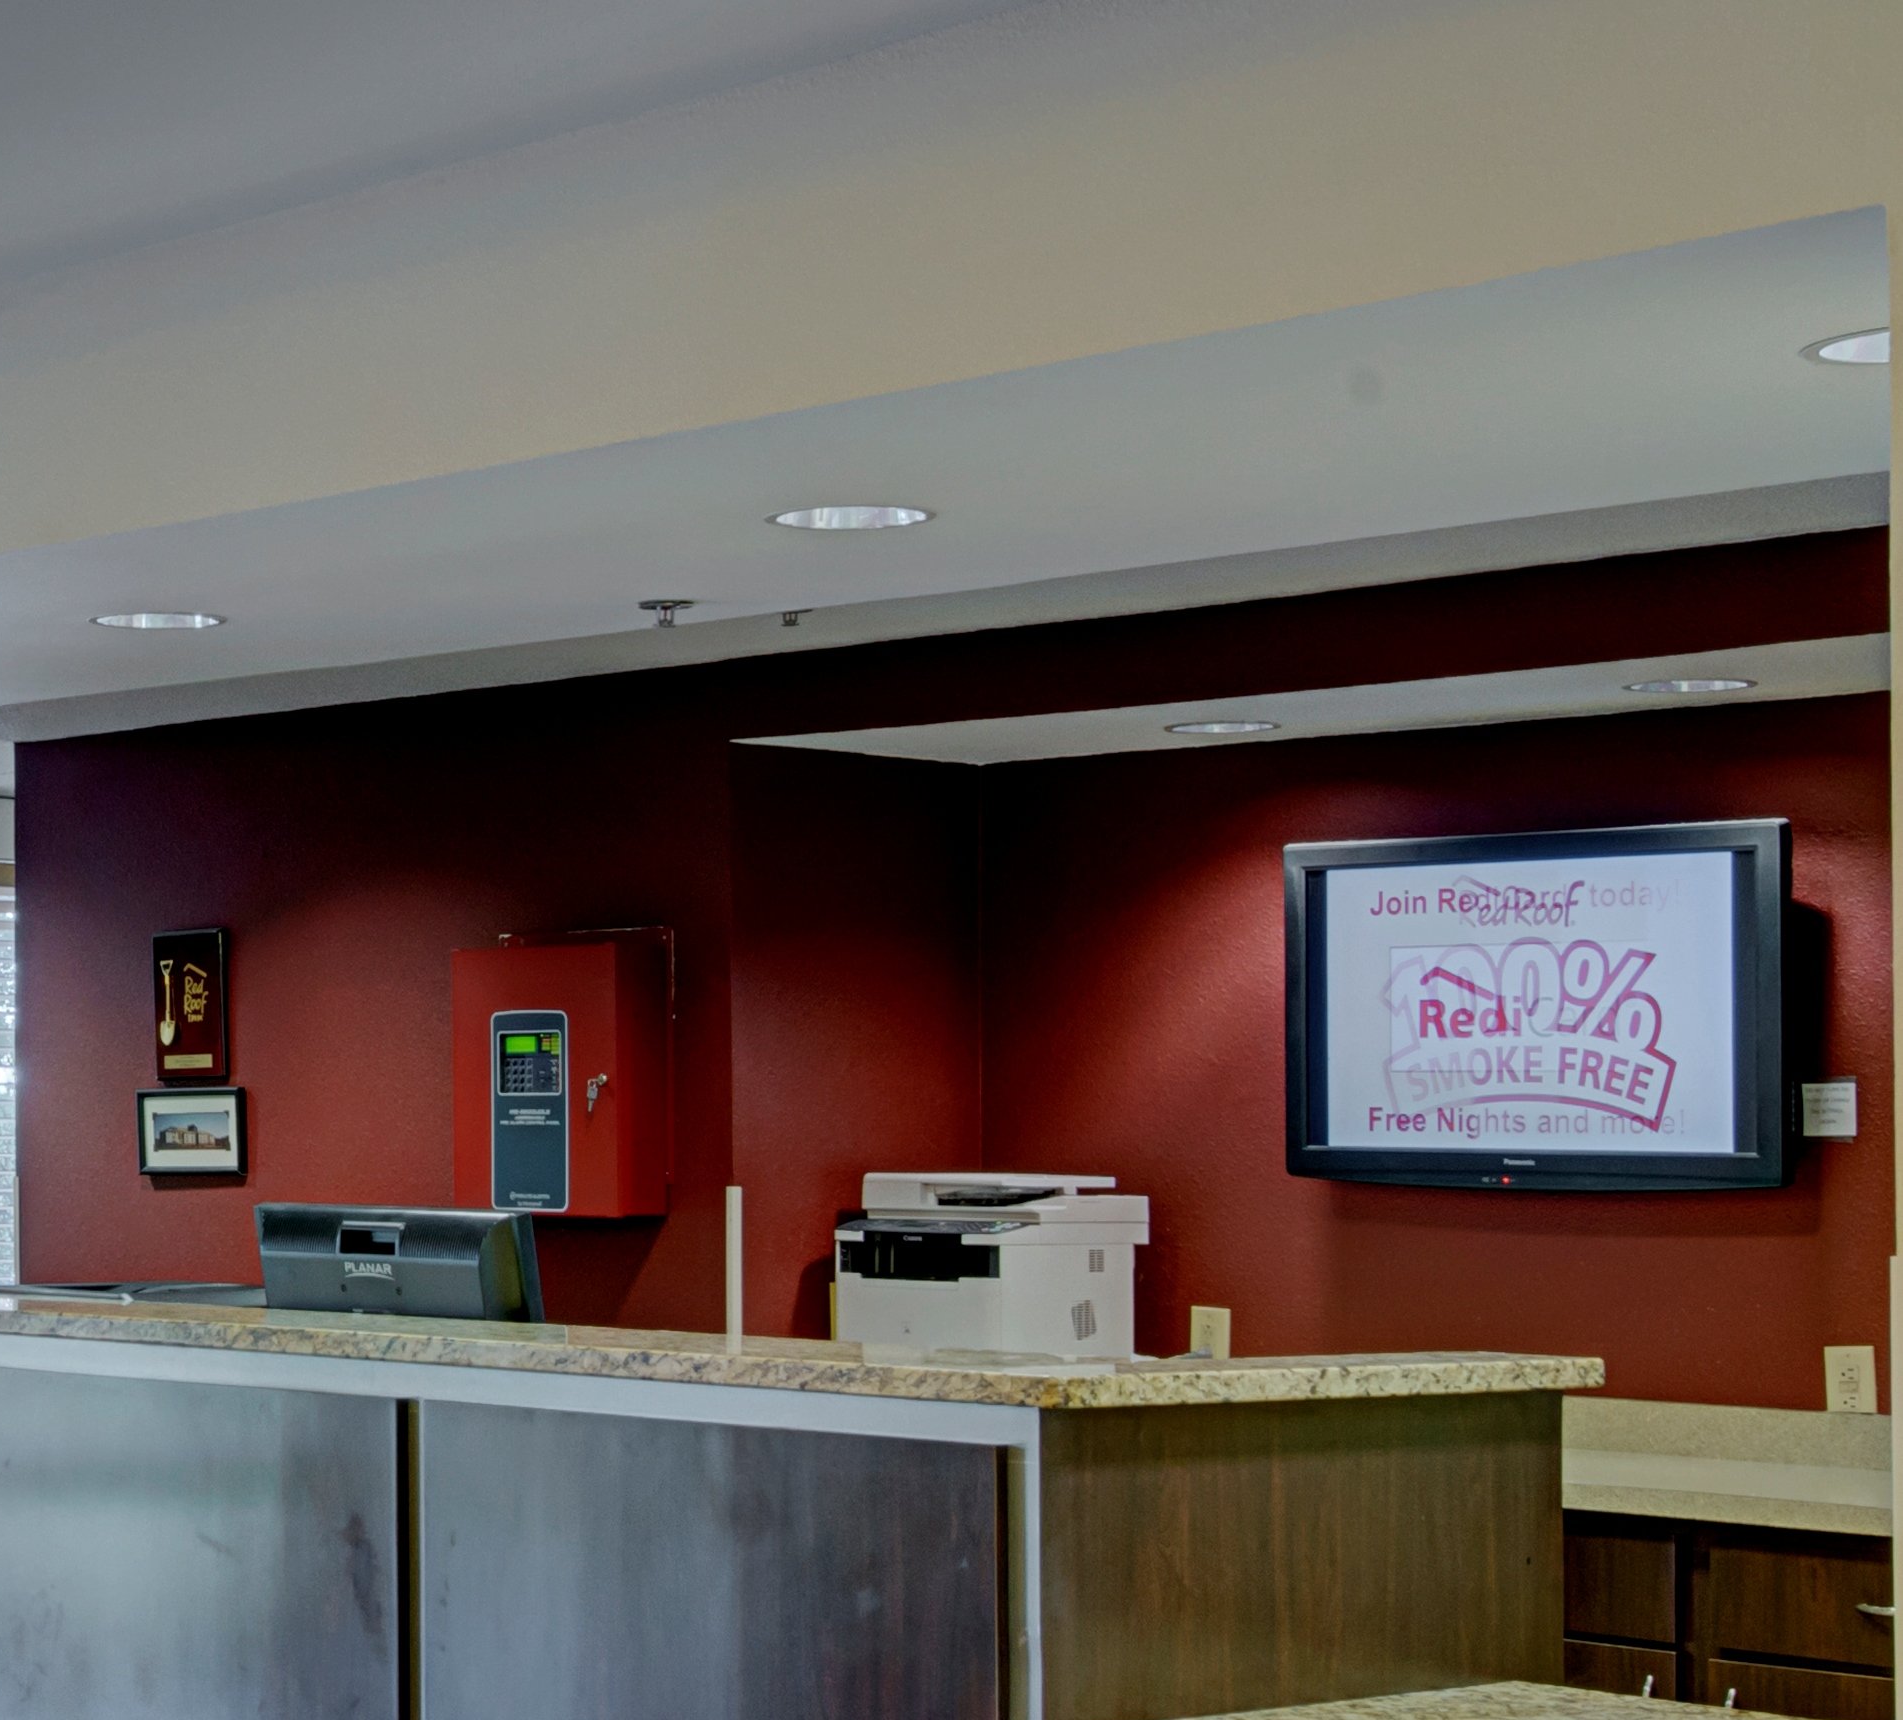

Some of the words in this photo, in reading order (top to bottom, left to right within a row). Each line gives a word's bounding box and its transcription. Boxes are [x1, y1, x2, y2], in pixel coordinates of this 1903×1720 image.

[1370, 890, 1427, 916] Join
[185, 976, 204, 995] Red
[184, 991, 209, 1015] Roof
[1405, 1046, 1544, 1103] SMOKE
[1556, 1046, 1655, 1106] FREE
[1369, 1107, 1427, 1133] Free
[1437, 1107, 1527, 1139] Nights
[1537, 1109, 1592, 1135] and
[344, 1261, 393, 1276] PLANAR
